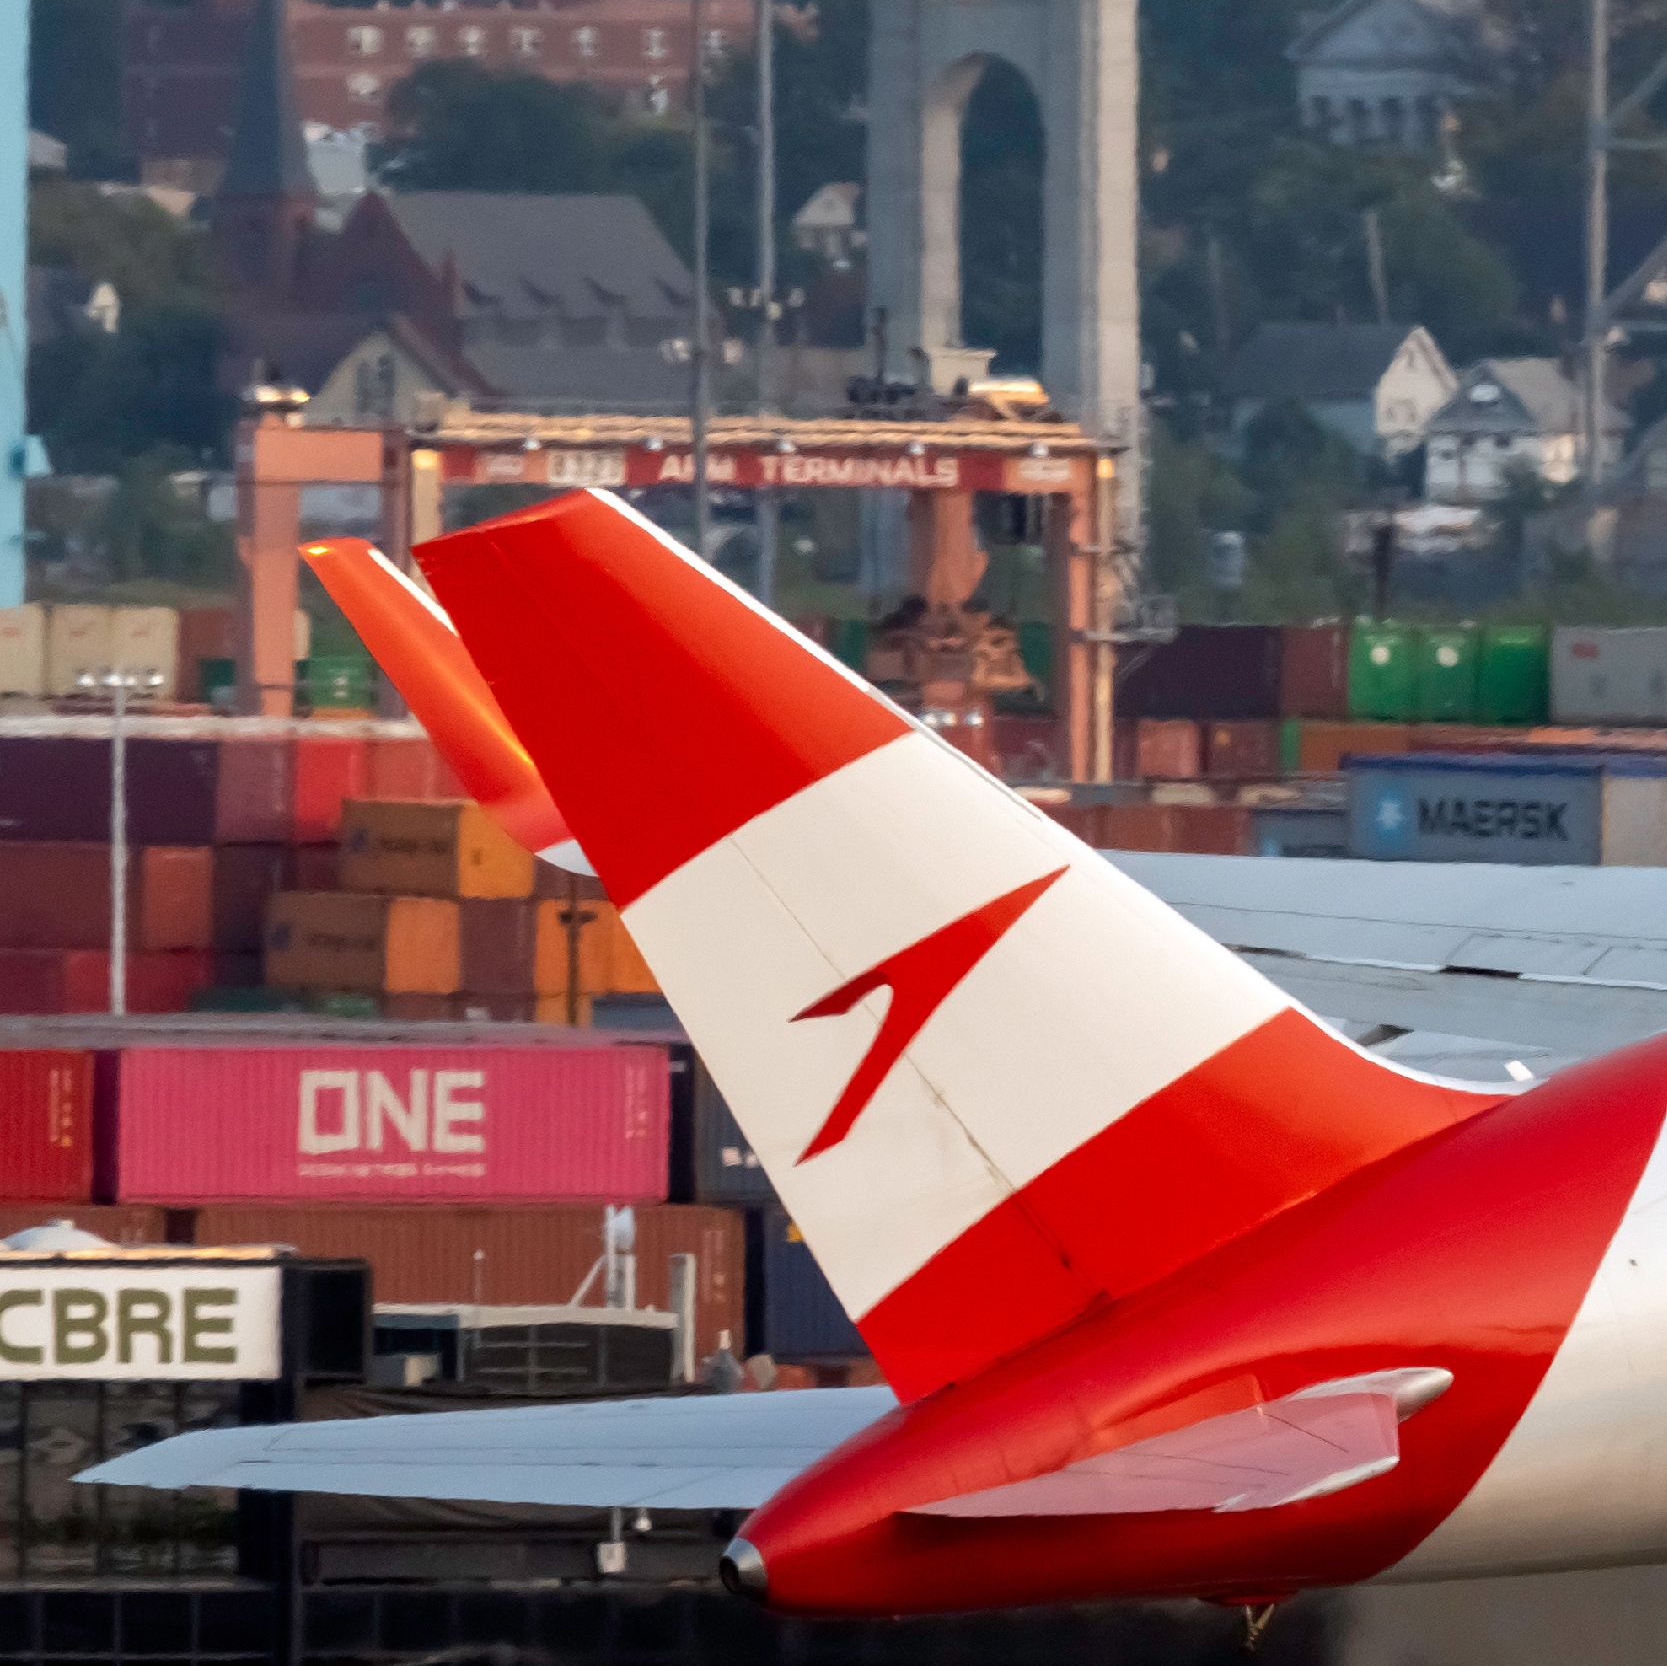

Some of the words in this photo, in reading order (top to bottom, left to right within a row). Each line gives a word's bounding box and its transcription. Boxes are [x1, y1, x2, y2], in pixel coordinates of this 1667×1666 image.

[759, 455, 959, 485] TERMINALS
[1417, 798, 1569, 841] MAERSK
[299, 1069, 486, 1155] ONE
[0, 1288, 238, 1364] CBRE
